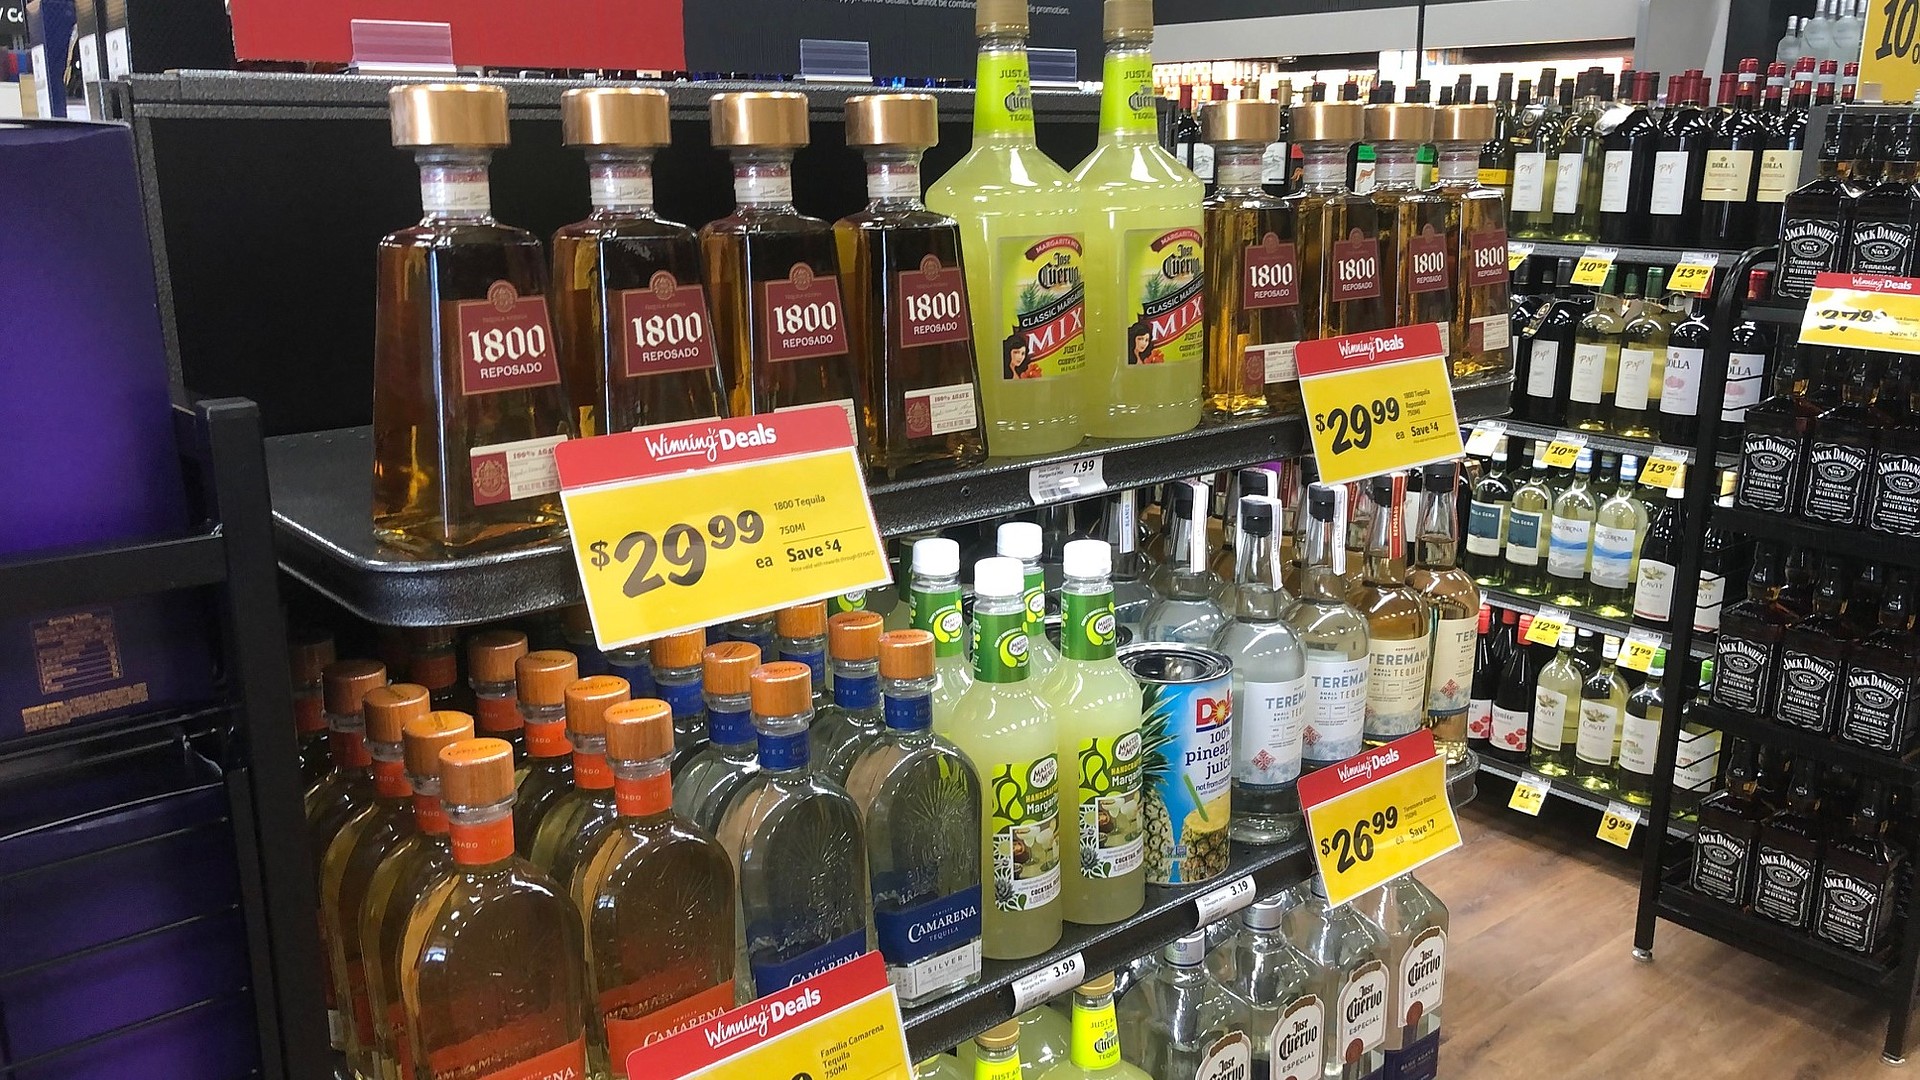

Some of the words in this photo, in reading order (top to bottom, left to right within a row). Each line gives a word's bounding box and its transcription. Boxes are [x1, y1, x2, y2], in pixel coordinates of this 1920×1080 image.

[1000, 70, 1022, 78] JUST
[1124, 70, 1146, 79] JUST
[1784, 226, 1806, 241] JACK
[1806, 222, 1840, 244] DANIEL'S
[1854, 229, 1876, 245] JACK
[1876, 226, 1912, 248] DANIEL'S
[1177, 244, 1193, 258] Jose
[1474, 246, 1505, 268] 1800
[1053, 252, 1071, 268] Jose
[1338, 256, 1376, 280] 1800
[1413, 250, 1444, 272] 1800
[1038, 262, 1079, 290] Cuervo
[1250, 262, 1293, 288] 1800
[1416, 273, 1442, 284] REPOSADO
[1342, 280, 1374, 292] REPOSADO
[1852, 276, 1884, 292] Winning
[1884, 279, 1912, 290] Deals
[1254, 288, 1290, 299] REPOSADO
[905, 290, 961, 323] 1800
[1146, 296, 1180, 316] CLASSIC
[774, 300, 838, 336] 1800
[1022, 306, 1057, 328] CLASSIC
[1150, 296, 1202, 342] MIX
[630, 310, 703, 350] 1800
[913, 320, 958, 336] REPOSADO
[1028, 306, 1083, 355] MIX
[468, 324, 547, 364] 1800
[782, 334, 834, 350] REPOSADO
[1338, 337, 1375, 361] Winning
[1375, 334, 1405, 353] Deals
[642, 346, 700, 362] REPOSADO
[480, 362, 542, 380] REPOSADO
[1396, 431, 1406, 440] ea
[1410, 425, 1430, 437] Save
[644, 427, 718, 462] Winning
[720, 422, 777, 449] Deals
[1745, 441, 1764, 454] JACK
[1766, 438, 1796, 462] DANIEL'S
[1072, 460, 1095, 474] 7.99
[1811, 451, 1832, 464] JACK
[1832, 448, 1867, 472] DANIEL'S
[1878, 461, 1901, 476] JACK
[1748, 479, 1782, 490] WHISKEY
[774, 500, 794, 511] 1800
[794, 494, 826, 508] Tequila
[1815, 489, 1850, 500] WHISKEY
[1882, 501, 1920, 514] WHISKEY
[755, 554, 774, 570] ea
[786, 544, 824, 563] Save
[825, 538, 842, 552] $4
[1718, 641, 1738, 655] JACK
[1783, 657, 1803, 671] JACK
[1848, 674, 1870, 688] JACK
[1210, 728, 1230, 744] 100%
[1337, 757, 1372, 784] Winning
[1372, 748, 1400, 770] Deals
[1195, 783, 1206, 792] not
[1206, 780, 1216, 788] from
[1409, 825, 1428, 838] Save
[1698, 832, 1716, 846] JACK
[1115, 850, 1136, 864] COCKTAIL
[1760, 854, 1779, 866] JACK
[1030, 882, 1052, 896] COCKTAIL
[1230, 880, 1248, 896] 3.19
[1824, 876, 1844, 889] JACK
[908, 905, 977, 944] CAMARENA
[928, 926, 959, 942] TEQUILA
[1419, 948, 1434, 963] Jose
[927, 955, 964, 974] SILVER
[1052, 959, 1076, 978] 3.99
[1408, 954, 1441, 988] Cuervo
[1360, 982, 1374, 996] Jose
[1410, 978, 1438, 998] ESPECIAL
[1346, 989, 1382, 1024] Cuervo
[704, 1004, 770, 1050] Winning
[770, 988, 822, 1024] Deals
[1090, 1020, 1108, 1028] JUST
[1292, 1018, 1308, 1032] Jose
[1348, 1015, 1380, 1035] ESPECIAL
[820, 1040, 848, 1058] Familia
[848, 1024, 885, 1048] Camarena
[1279, 1026, 1318, 1060] Cuervo
[822, 1050, 851, 1070] Tequila
[1219, 1056, 1236, 1070] Jose
[1282, 1050, 1315, 1074] ESPECIAL
[991, 1069, 1010, 1080] JUST
